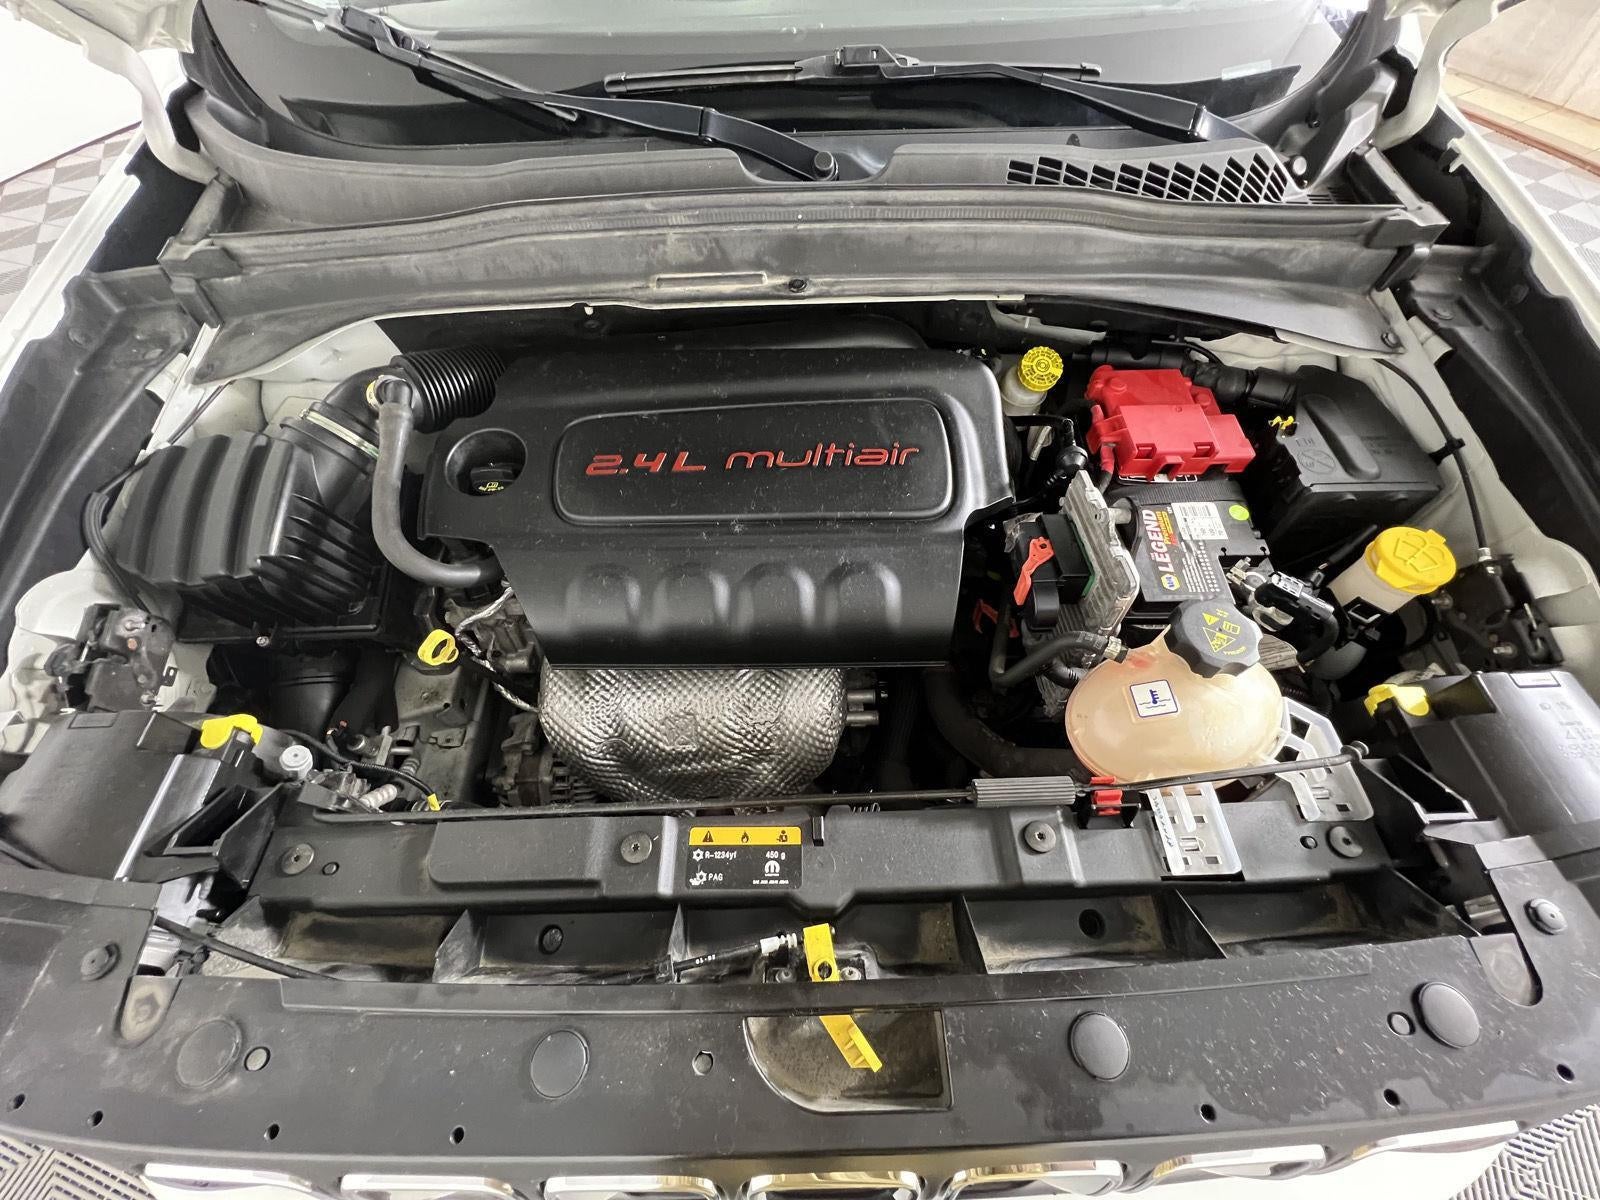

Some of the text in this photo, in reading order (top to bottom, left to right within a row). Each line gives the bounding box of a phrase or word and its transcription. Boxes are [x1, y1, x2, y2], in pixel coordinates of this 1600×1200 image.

[725, 442, 920, 470] multiair
[1142, 509, 1175, 573] LEGEND
[705, 850, 786, 861] R-1234yf 450 g
[708, 873, 724, 881] PAG
